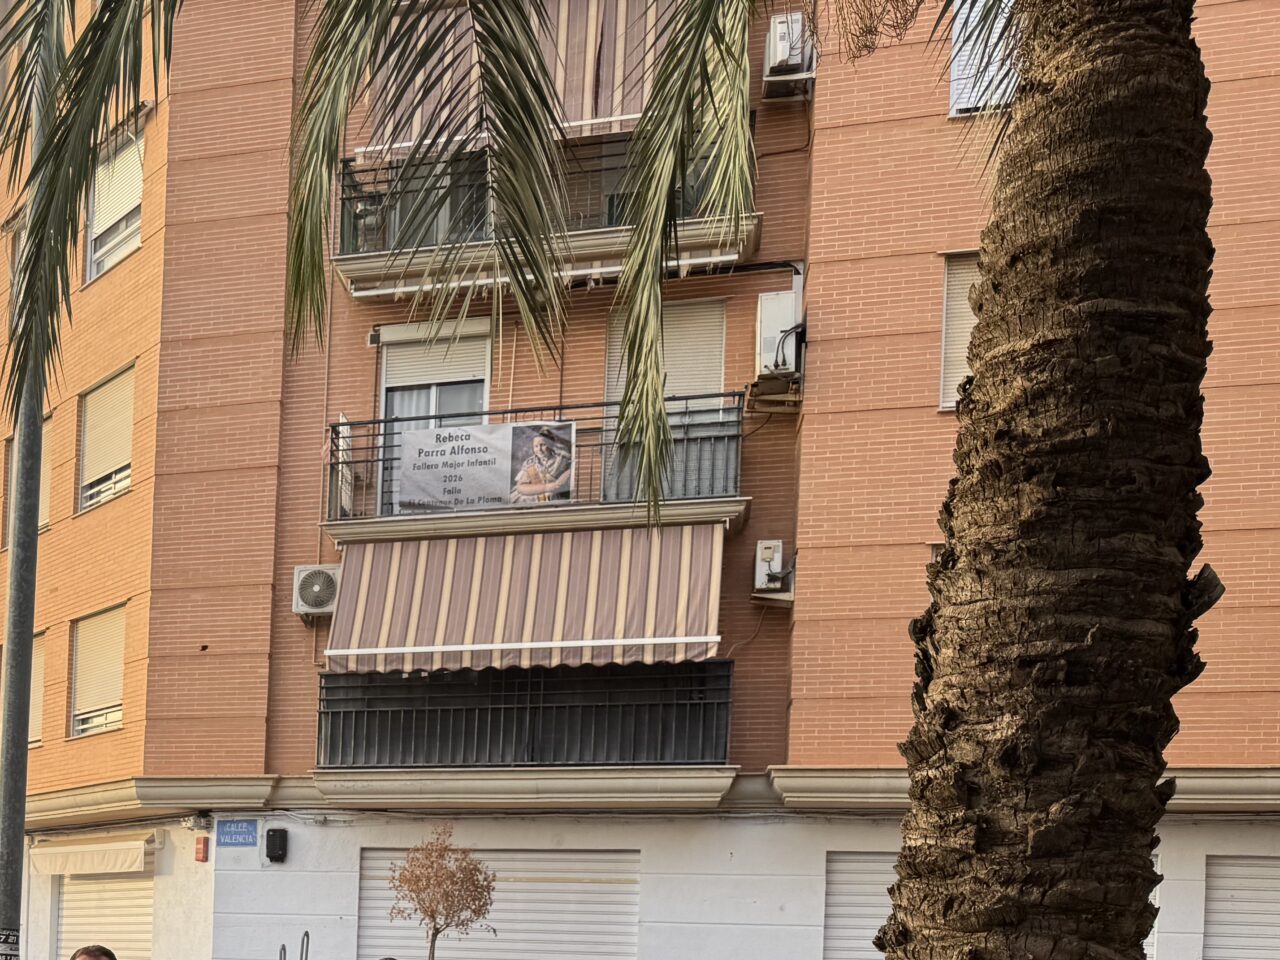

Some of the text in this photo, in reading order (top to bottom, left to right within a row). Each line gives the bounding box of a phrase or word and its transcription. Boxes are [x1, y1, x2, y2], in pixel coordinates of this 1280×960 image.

[435, 432, 471, 443] Rebeca
[418, 445, 488, 458] Parra Alfonso
[412, 457, 496, 471] Fallera Major Infantil
[443, 474, 463, 483] 2026
[443, 487, 461, 496] Falla
[454, 497, 464, 506] De
[466, 496, 475, 505] La
[477, 495, 502, 505] Ploma
[220, 834, 253, 843] VALENCIA
